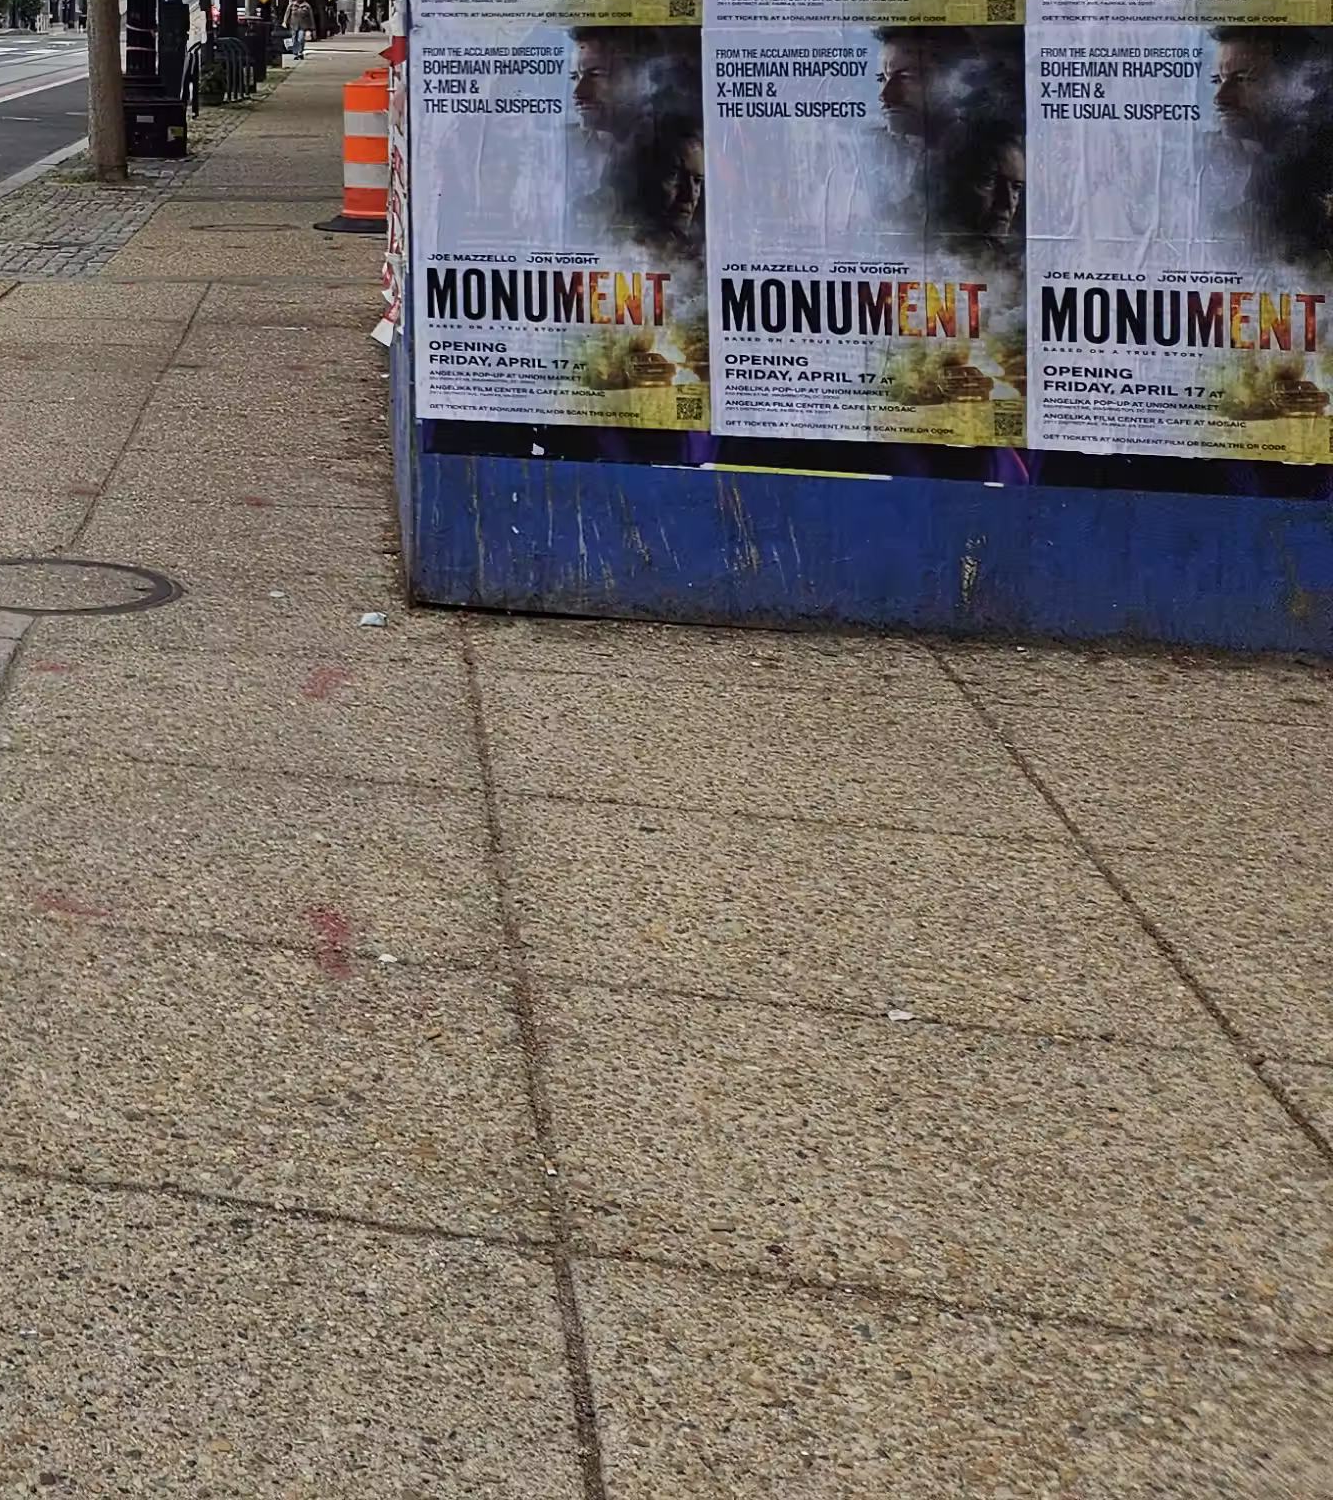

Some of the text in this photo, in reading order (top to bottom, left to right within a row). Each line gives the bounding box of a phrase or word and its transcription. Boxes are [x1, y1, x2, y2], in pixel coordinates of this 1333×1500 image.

[423, 59, 564, 75] BOHEMIAN RHAPSODY
[716, 61, 868, 77] BOHEMIAN RHAPSODY
[1041, 61, 1202, 78] BOHEMIAN RHAPSODY
[423, 99, 562, 114] THE USUAL SUSPECTS
[717, 102, 866, 118] THE USUAL SUSPECTS
[1041, 103, 1200, 120] THE USUAL SUSPECTS
[426, 267, 671, 326] MONUMENT
[721, 278, 987, 338] MONUMENT
[1041, 286, 1326, 352] MONUMENT
[429, 341, 507, 353] OPENING
[429, 355, 569, 370] FRIDAY, APRIL 17
[725, 354, 808, 367] OPENING
[725, 369, 877, 384] FRIDAY, APRIL 17
[1043, 366, 1133, 379] OPENING
[1043, 380, 1205, 398] FRIDAY, APRIL 17
